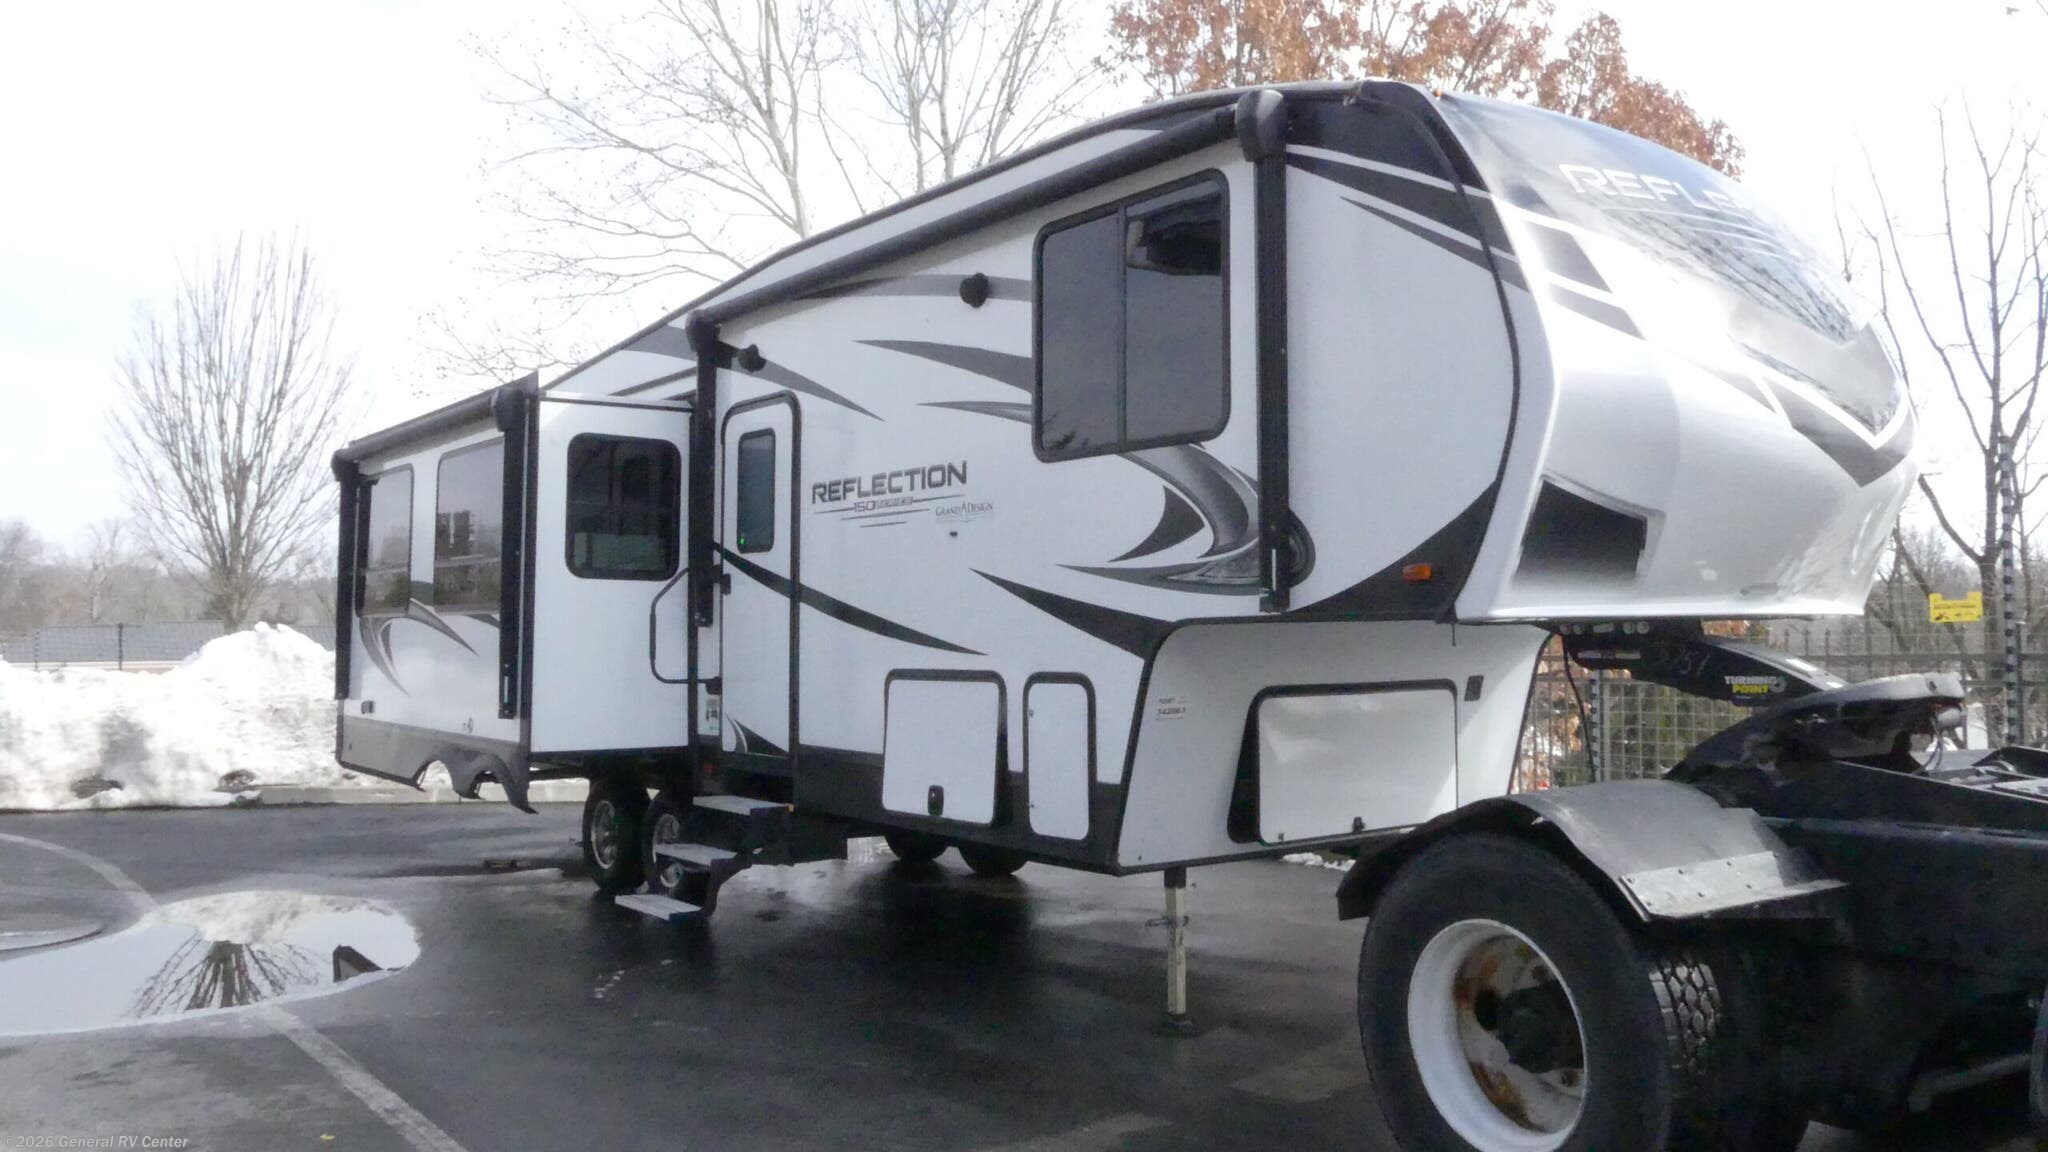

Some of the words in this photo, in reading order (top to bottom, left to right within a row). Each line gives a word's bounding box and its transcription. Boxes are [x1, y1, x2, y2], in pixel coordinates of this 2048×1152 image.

[812, 460, 968, 504] REFLECTION
[1724, 675, 1777, 685] TURNING
[1732, 684, 1770, 694] POINT
